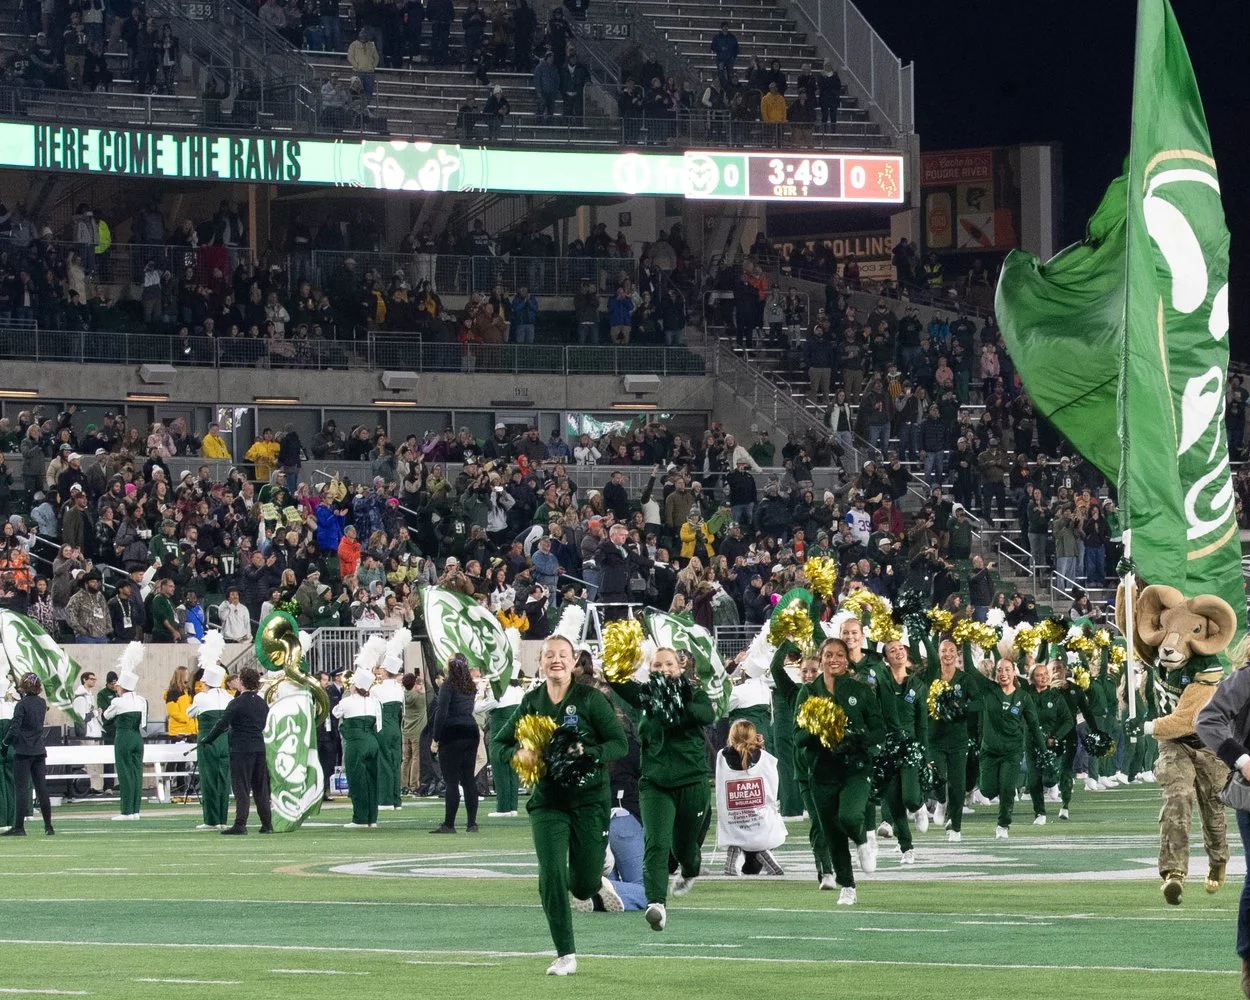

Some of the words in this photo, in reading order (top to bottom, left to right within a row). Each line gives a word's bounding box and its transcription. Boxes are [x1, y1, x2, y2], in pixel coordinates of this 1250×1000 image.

[605, 24, 628, 35] 240
[34, 125, 89, 170] HERE
[99, 130, 164, 175] COME
[172, 135, 219, 178] THE
[230, 138, 301, 182] RAMS
[724, 164, 739, 187] 0
[768, 158, 829, 186] 3:49
[850, 166, 866, 189] 0
[925, 167, 961, 179] POUDRE
[962, 165, 988, 177] RIVER
[773, 185, 798, 196] QTR
[801, 185, 809, 196] 1
[221, 556, 235, 574] 17
[729, 790, 761, 799] BUREAU
